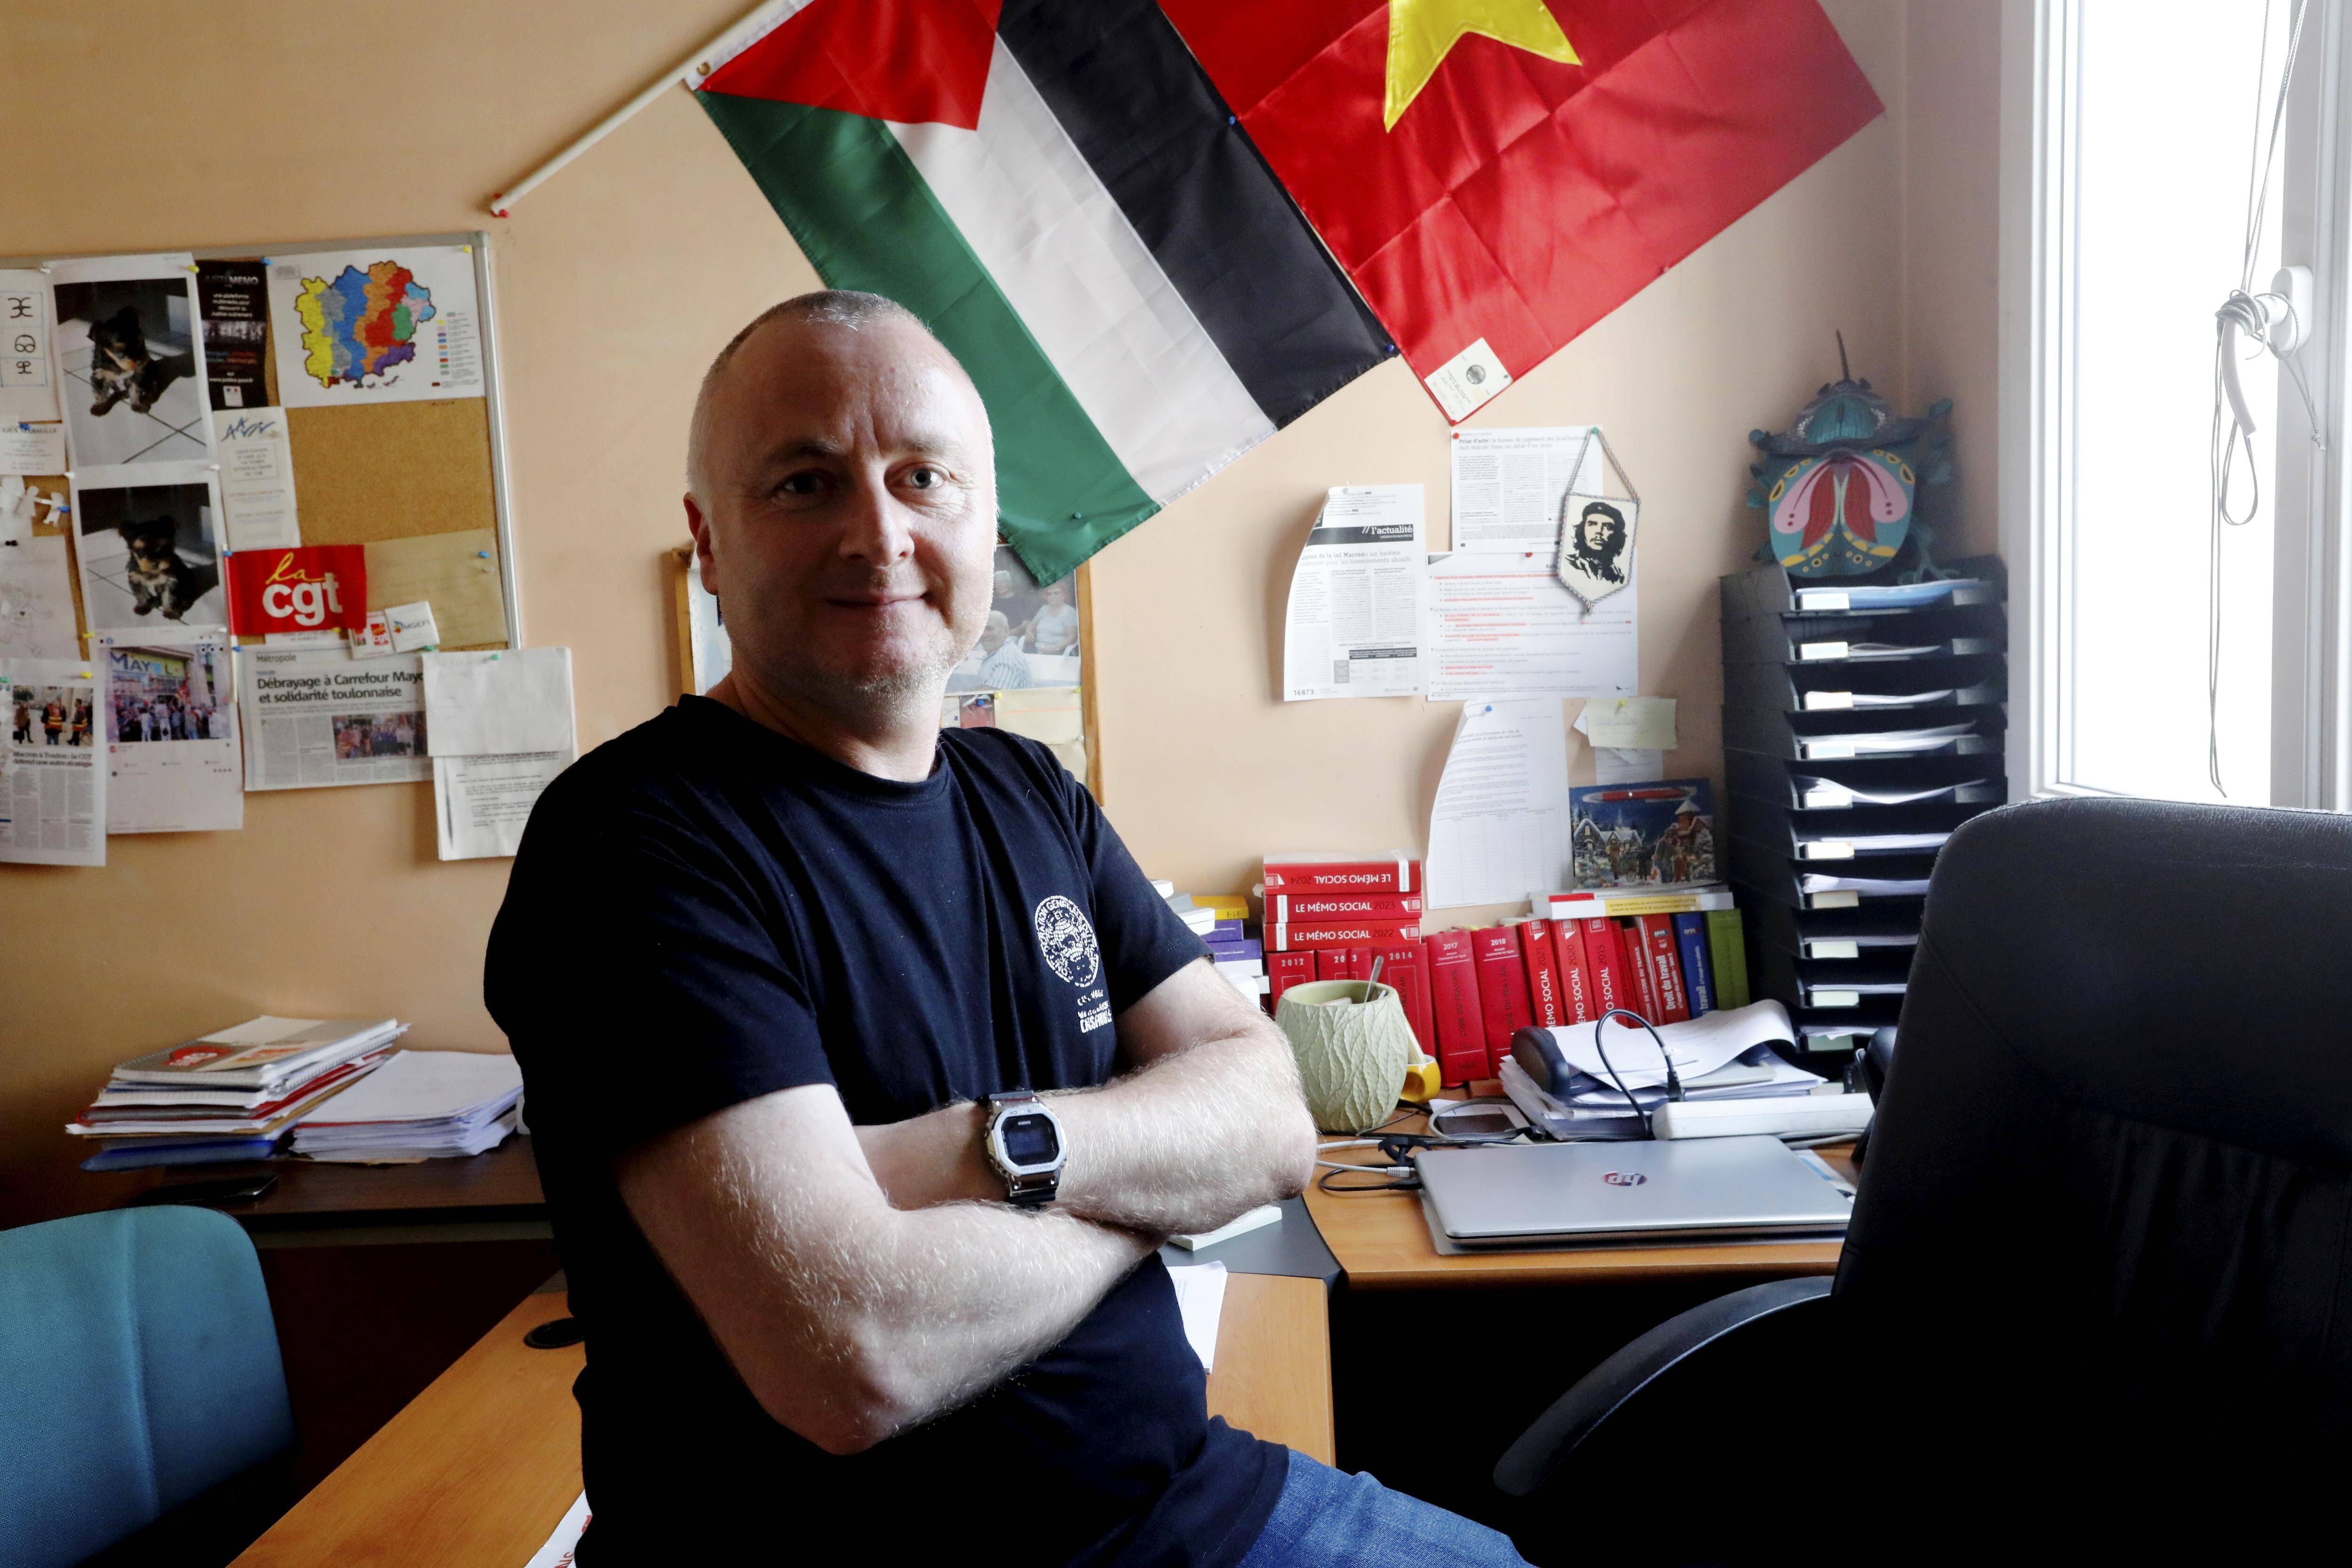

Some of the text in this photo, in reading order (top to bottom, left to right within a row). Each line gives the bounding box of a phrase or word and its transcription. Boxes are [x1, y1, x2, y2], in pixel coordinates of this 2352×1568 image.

[1371, 525, 1413, 535] l'actualité
[262, 573, 342, 626] cgt
[258, 671, 423, 690] Débrayage à Carrefour Mayo
[259, 686, 402, 703] et solidarité toulonnaise
[1291, 874, 1391, 884] LE MÉMO SOCIAL 2024
[1295, 901, 1395, 913] LE MÉMO SOCIAL 2023
[1295, 929, 1393, 941] LE MÉMO SOCIAL 2022
[1491, 938, 1506, 946] 2018
[1281, 958, 1304, 967] 2012
[1389, 951, 1412, 960] 2014
[1597, 944, 1607, 964] 2015
[1635, 946, 1643, 968] TRAVAIL
[1639, 969, 1645, 978] DU
[1540, 969, 1552, 1002] SOCIAL
[1567, 944, 1586, 1024] ÉMO SOCIAL 2020
[1600, 967, 1613, 1000] SOCIAL
[1656, 955, 1676, 1011] Droit du travail
[1696, 985, 1708, 1010] travail
